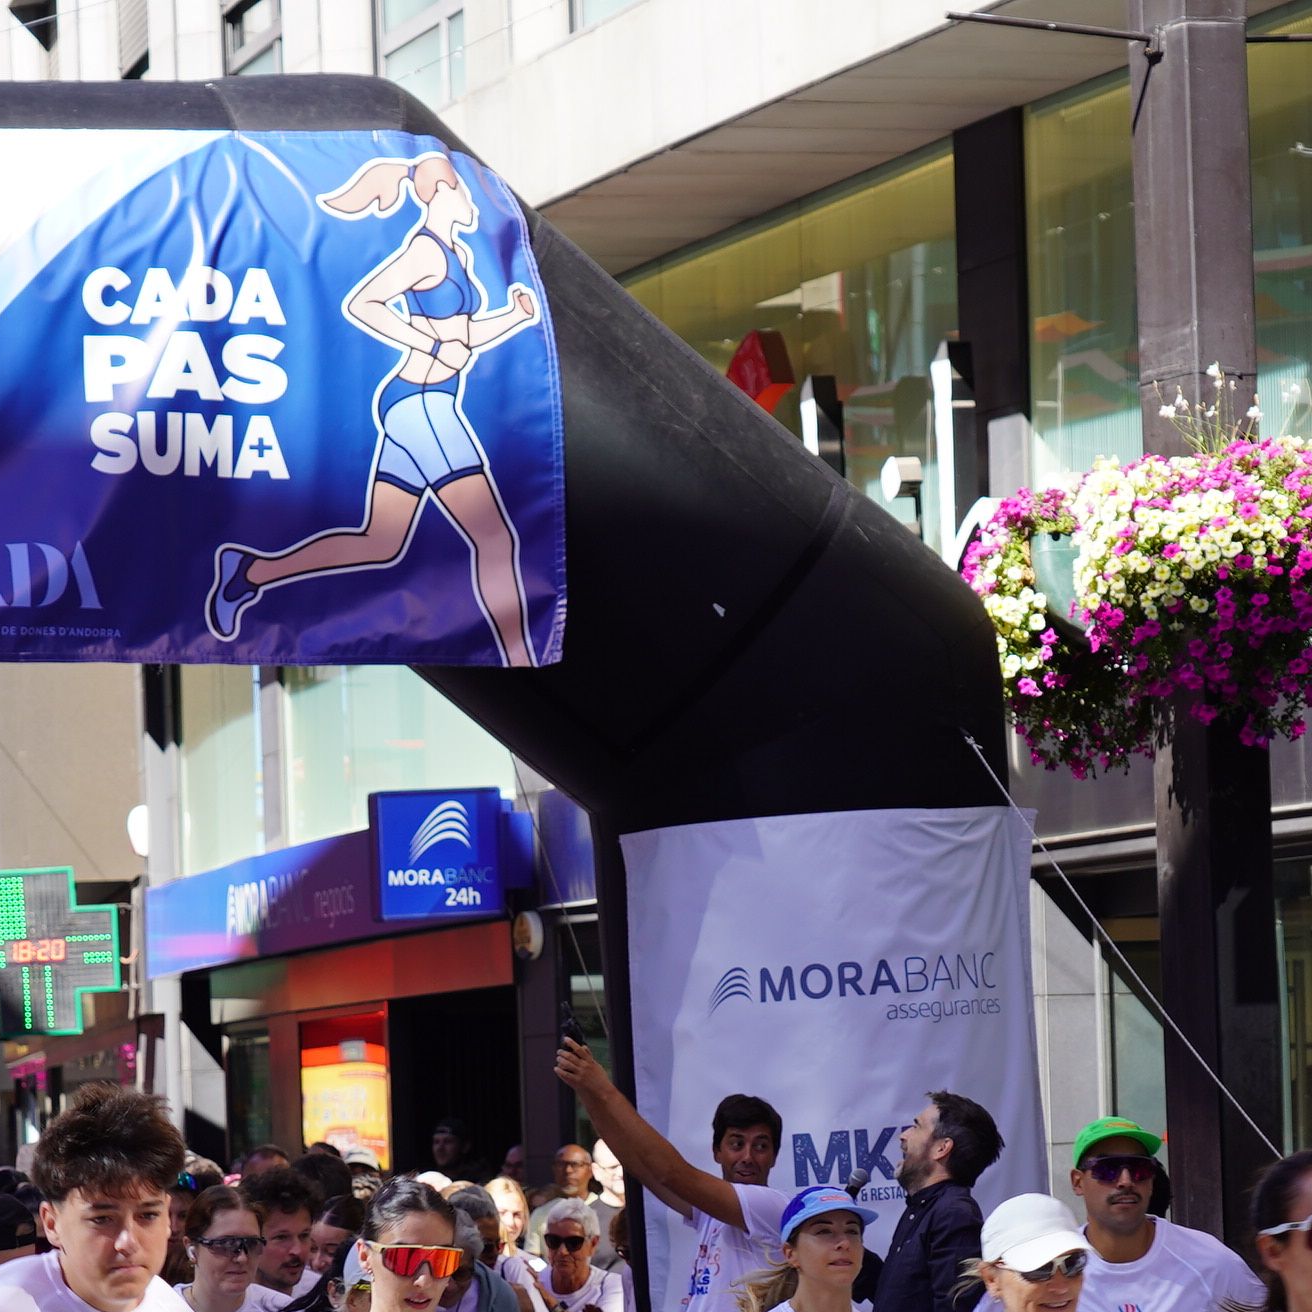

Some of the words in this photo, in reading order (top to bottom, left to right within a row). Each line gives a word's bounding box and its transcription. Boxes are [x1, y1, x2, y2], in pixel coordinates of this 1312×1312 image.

[80, 265, 288, 328] CADA
[84, 330, 289, 404] PAS
[89, 411, 291, 480] SUMA
[0, 625, 17, 636] DE
[19, 625, 56, 637] DONES
[58, 625, 122, 638] D'ANDORRA
[387, 865, 495, 887] MORABANC
[444, 887, 482, 907] 24h
[12, 939, 66, 963] 18:20
[758, 951, 997, 1003] MORABANC
[885, 996, 1001, 1023] assegurances
[791, 1126, 914, 1188] MK
